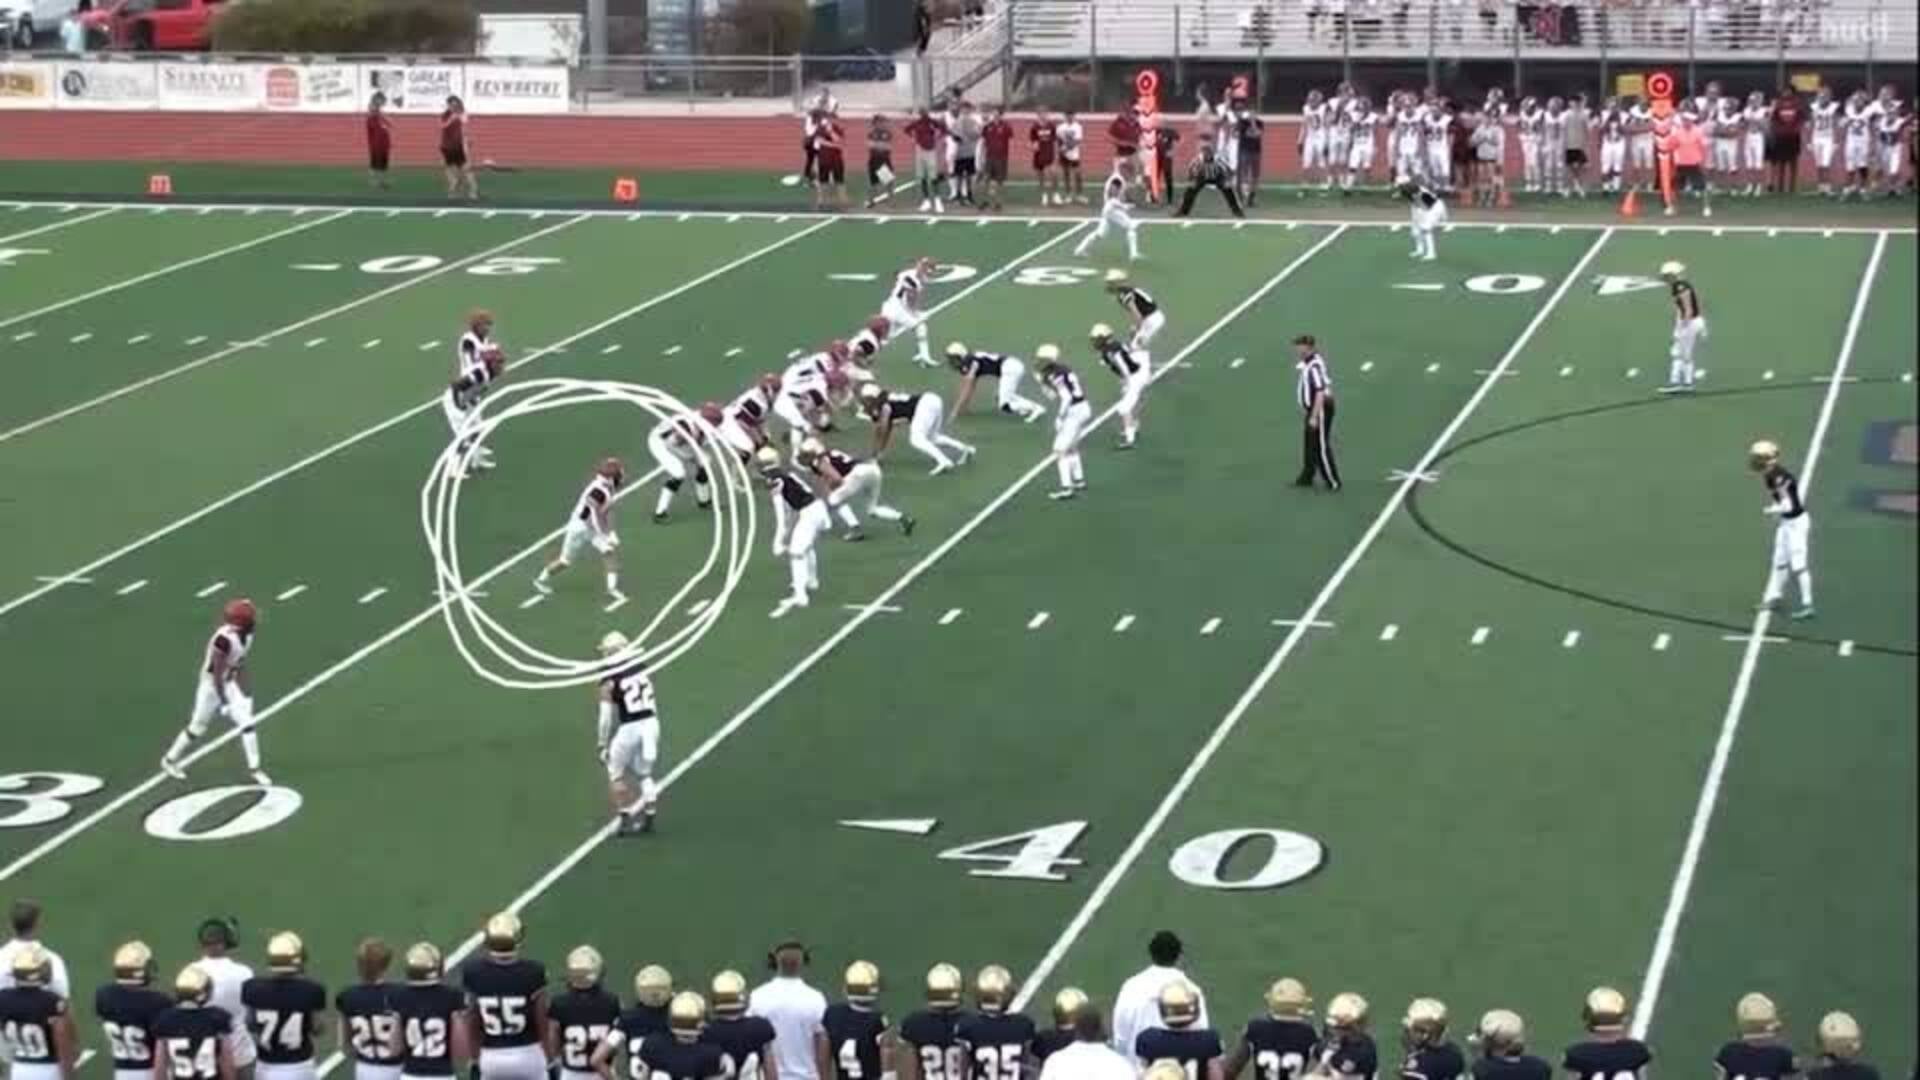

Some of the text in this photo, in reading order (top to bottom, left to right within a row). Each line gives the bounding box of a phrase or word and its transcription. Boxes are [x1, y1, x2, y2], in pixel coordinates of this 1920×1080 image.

[620, 674, 657, 713] 22
[255, 1010, 304, 1050] 74
[476, 996, 527, 1036] 55
[168, 1036, 217, 1077] 54
[838, 1038, 862, 1078] 4
[975, 1043, 1022, 1080] 35
